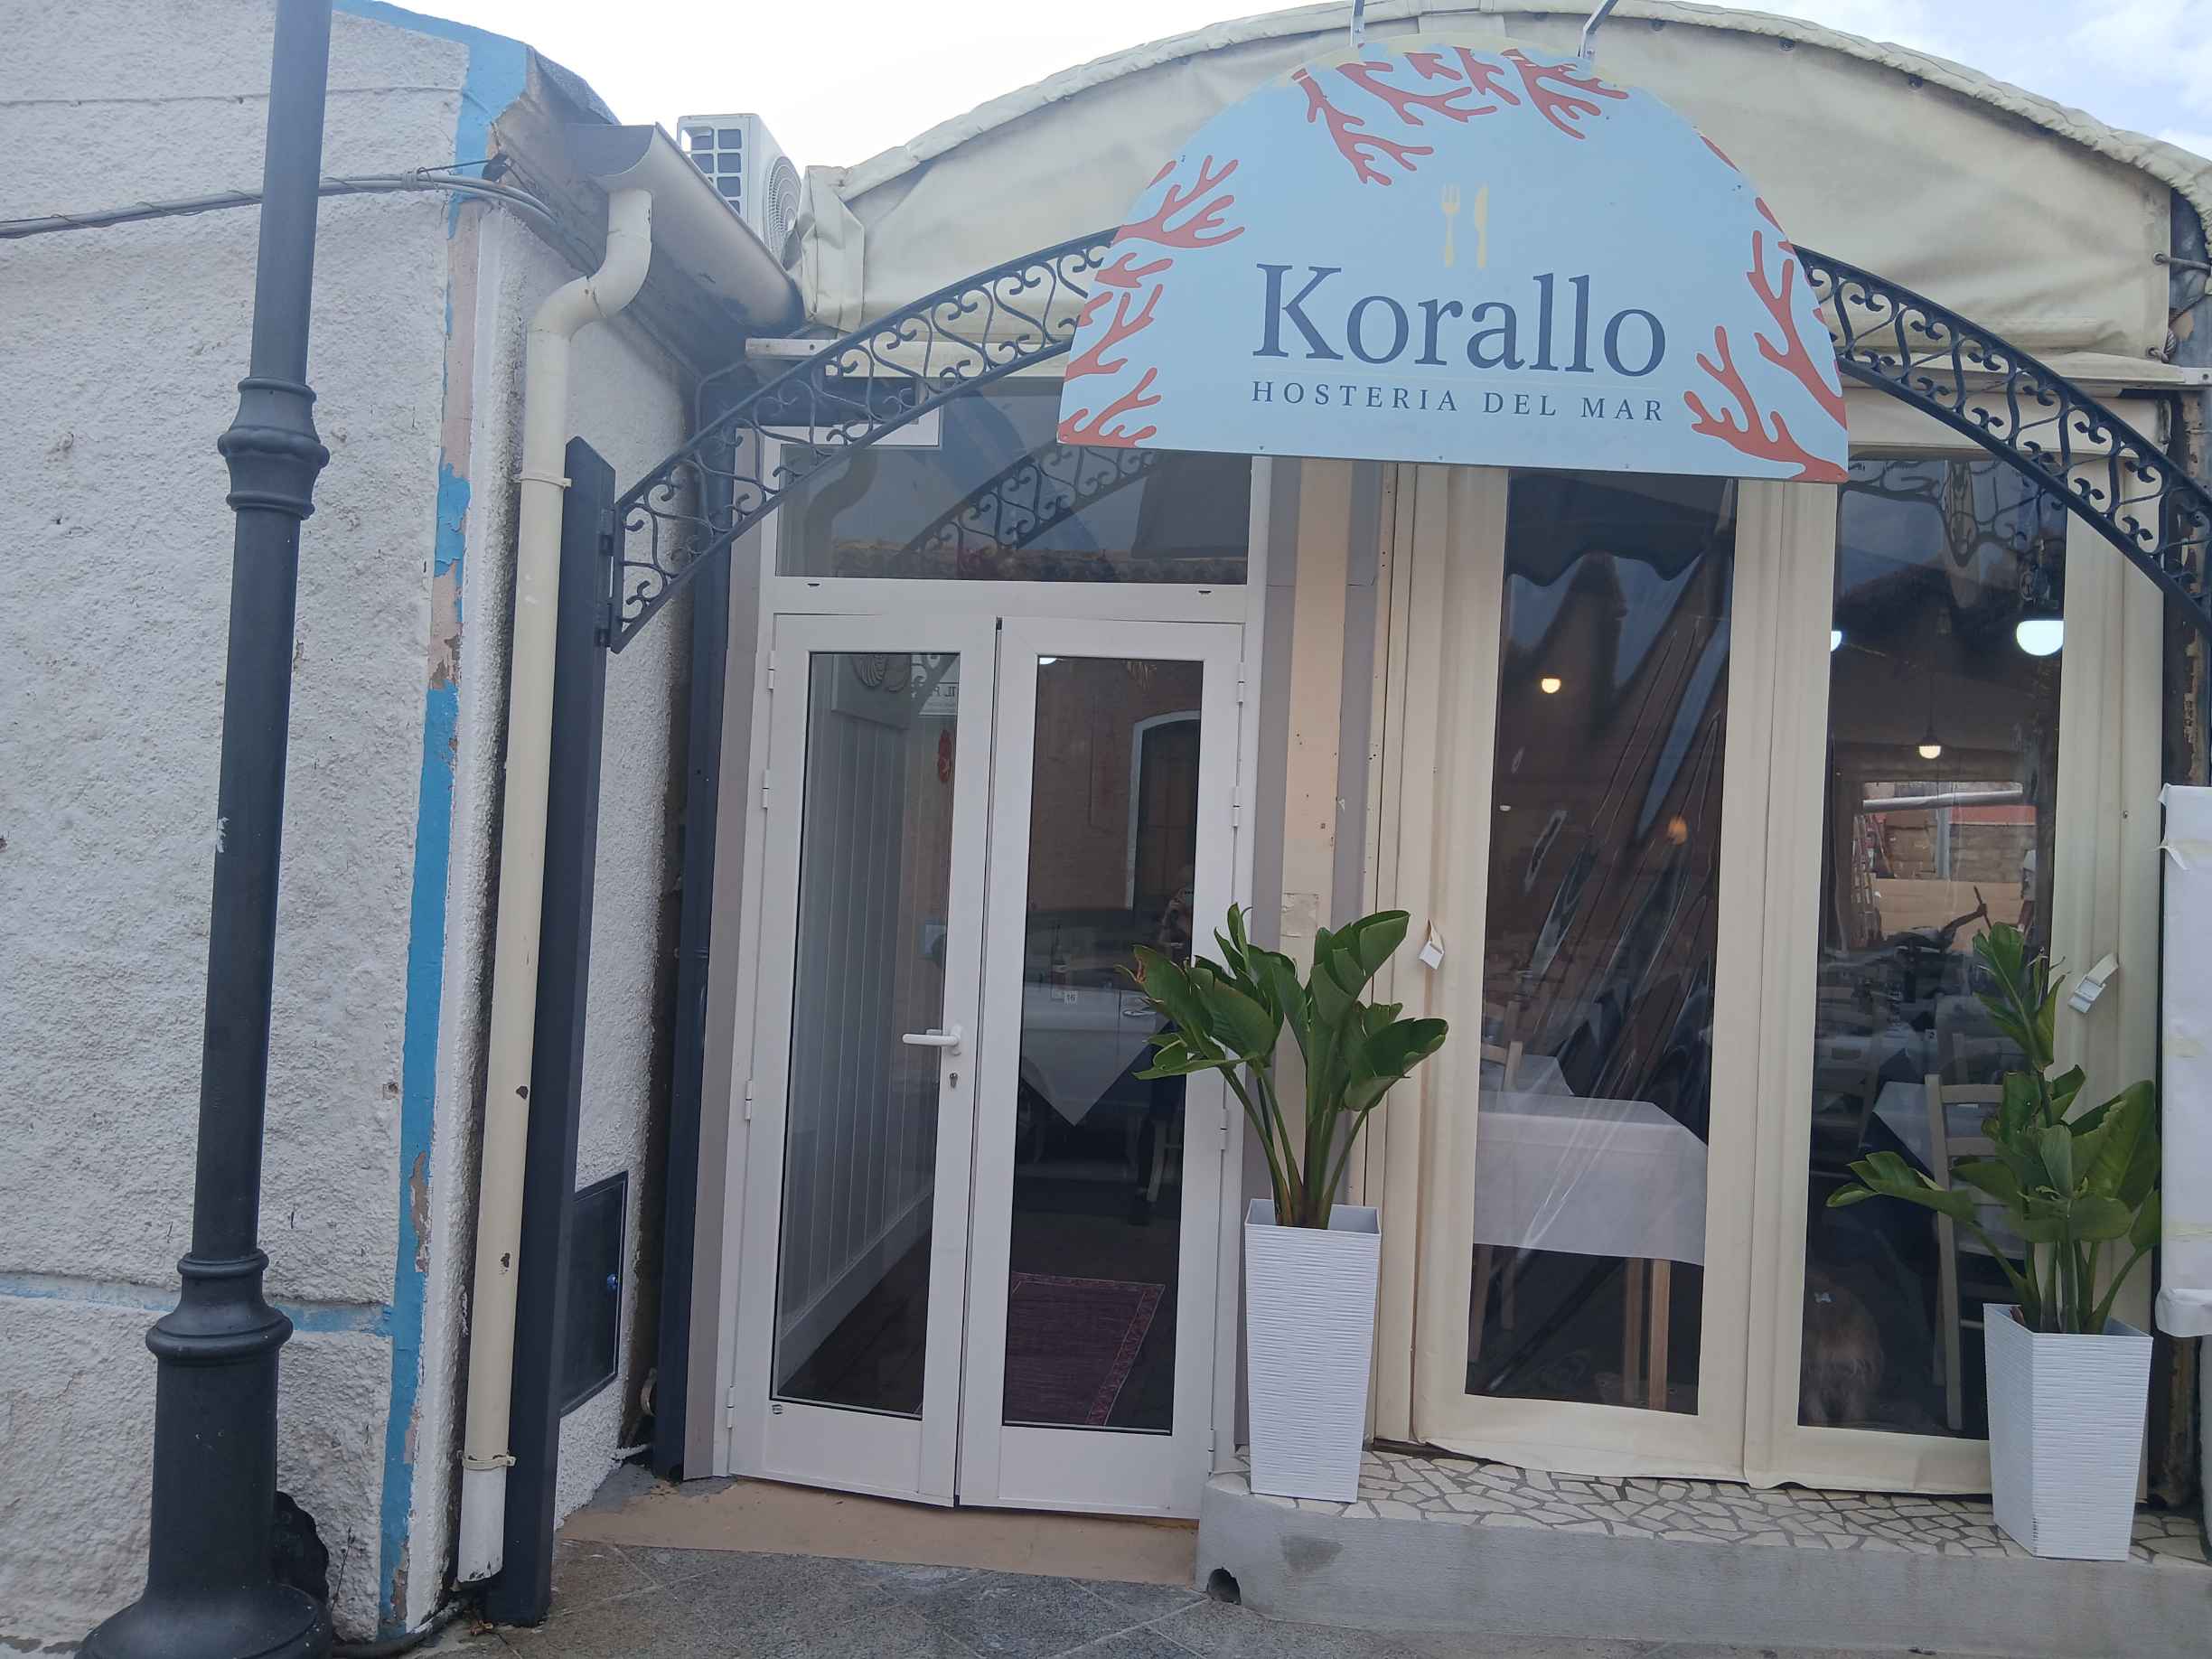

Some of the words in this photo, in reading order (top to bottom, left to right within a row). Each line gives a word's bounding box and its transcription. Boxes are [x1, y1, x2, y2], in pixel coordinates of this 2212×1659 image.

[1252, 263, 1667, 378] Korallo
[1251, 380, 1458, 412] HOSTERIA
[1483, 392, 1557, 417] DEL
[1580, 398, 1663, 422] MAR
